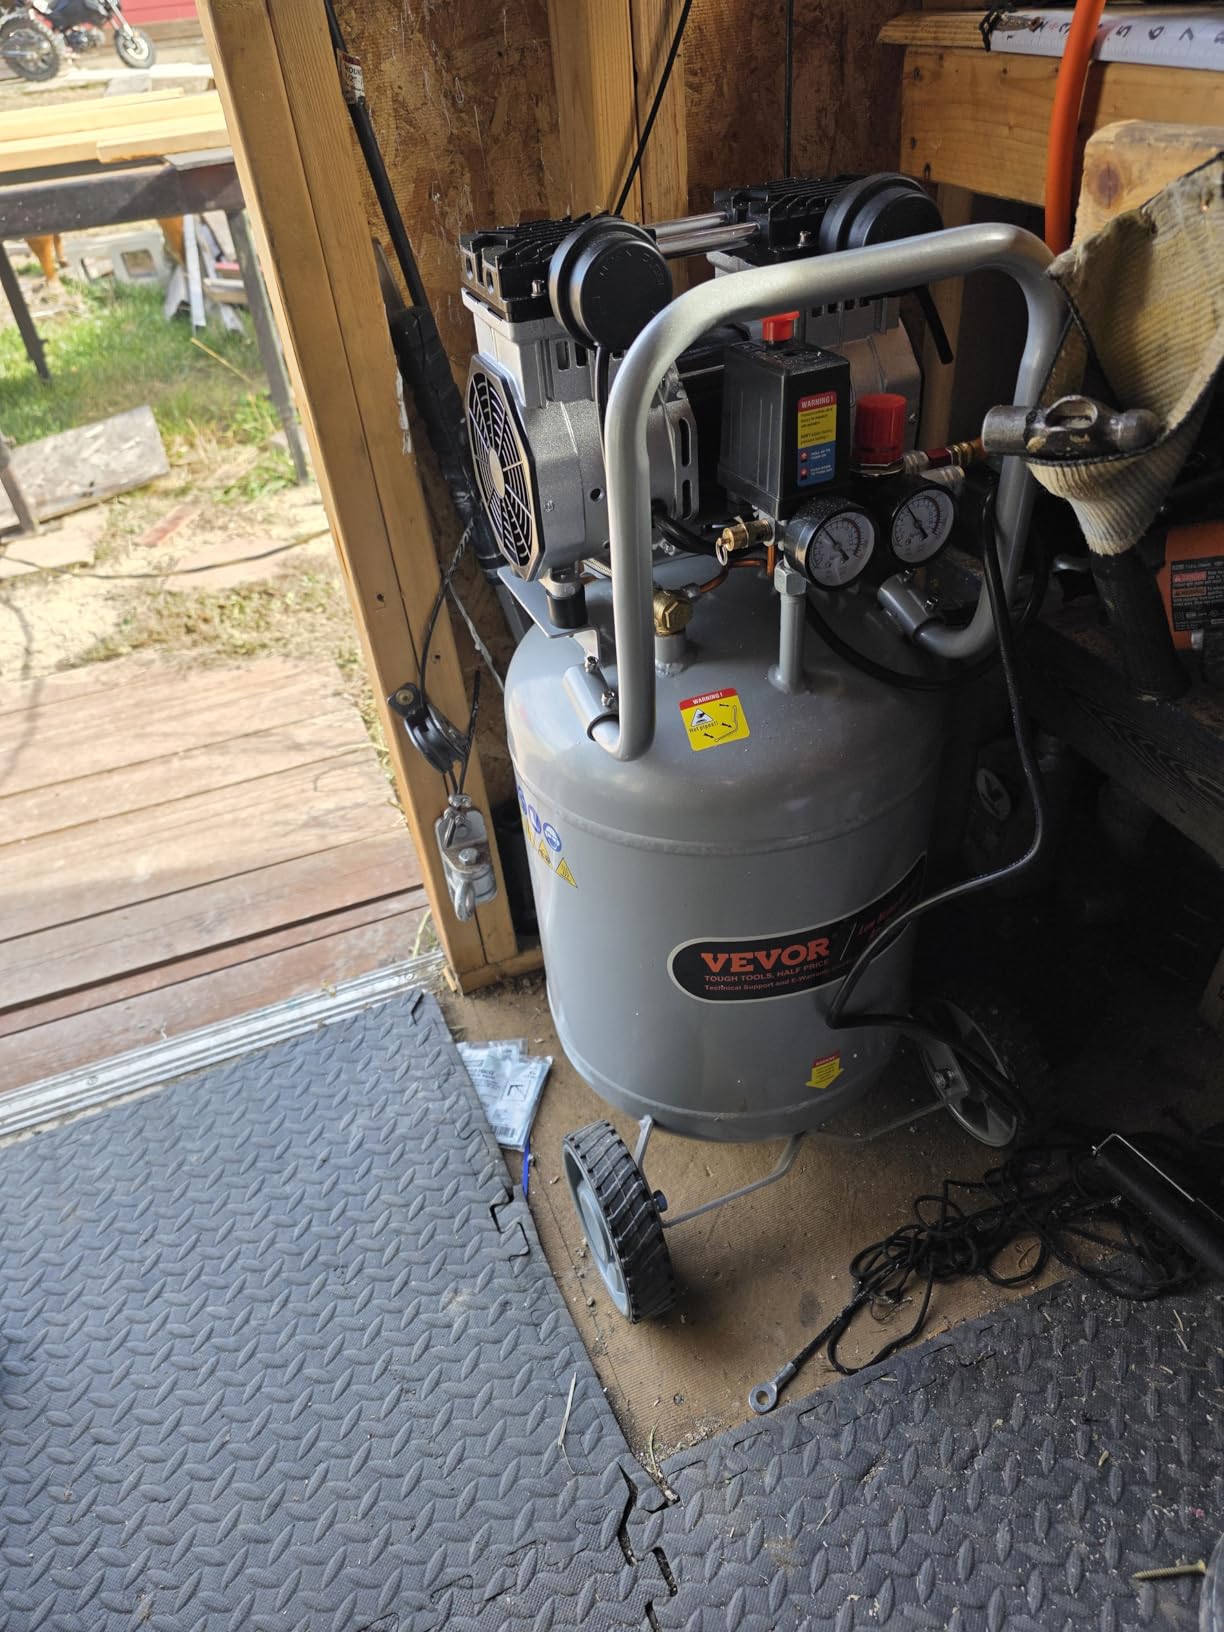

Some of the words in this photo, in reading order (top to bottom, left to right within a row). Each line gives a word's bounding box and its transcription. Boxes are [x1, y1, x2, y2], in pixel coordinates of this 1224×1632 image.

[700, 937, 830, 974] VEVOR
[704, 974, 738, 983] TOUGH
[776, 966, 802, 977] HALF
[803, 959, 830, 972] PRICE
[704, 984, 742, 992] Technical
[743, 981, 775, 992] Support
[775, 978, 791, 987] and
